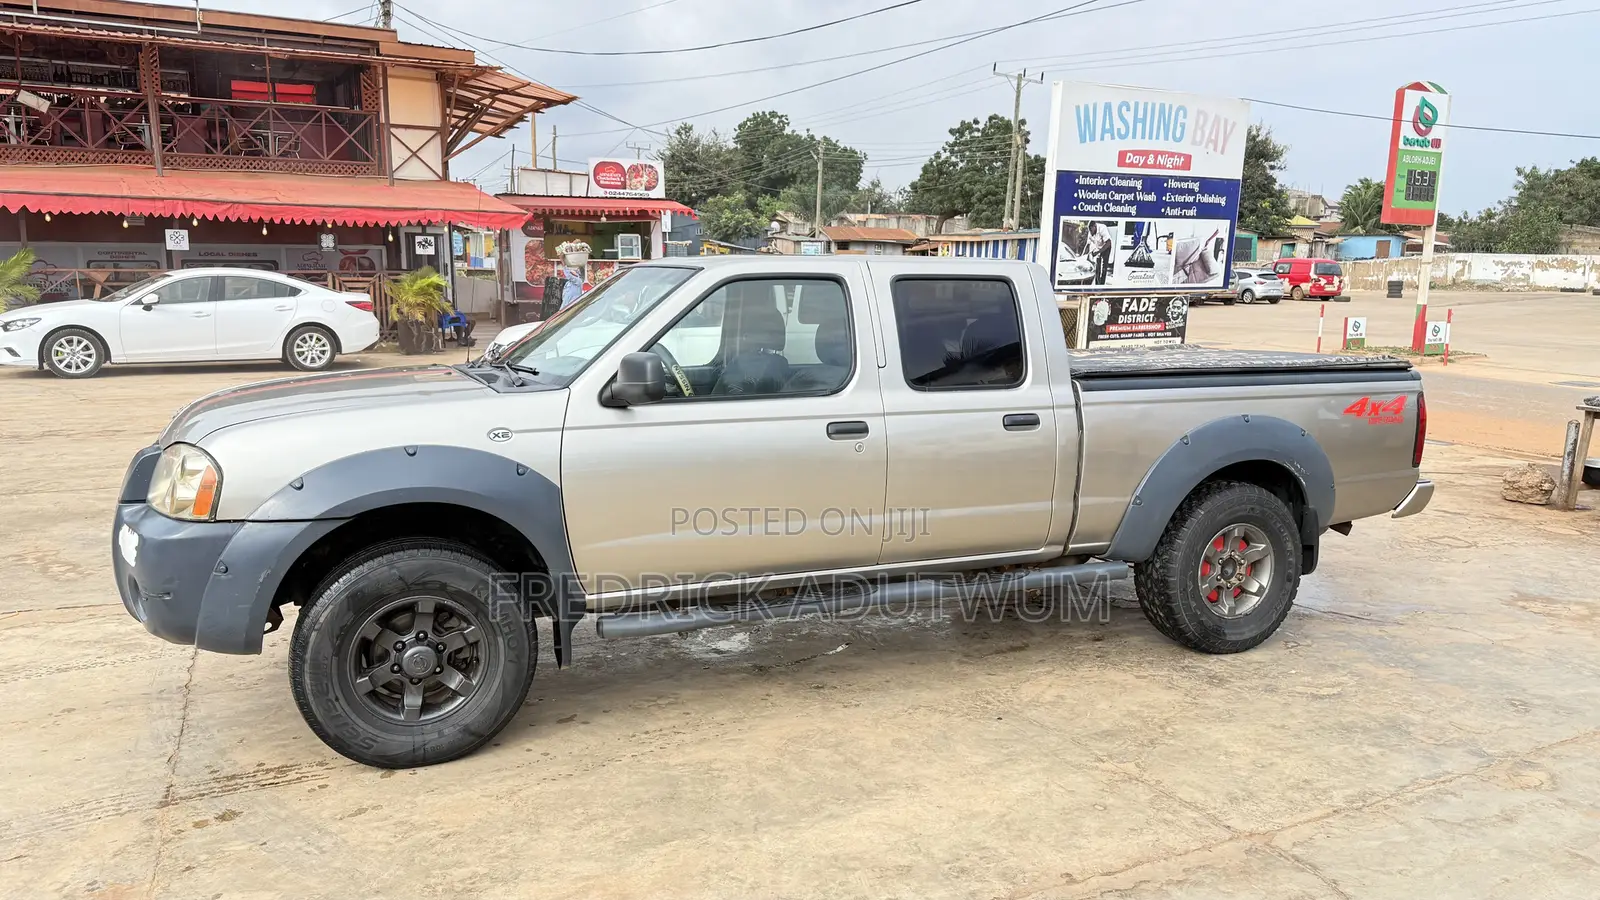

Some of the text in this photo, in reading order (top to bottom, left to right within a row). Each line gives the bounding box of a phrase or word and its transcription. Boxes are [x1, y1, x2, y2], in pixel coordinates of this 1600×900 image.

[1075, 100, 1237, 155] WASHING BAY
[1125, 153, 1185, 168] Day & Night
[1079, 175, 1143, 190] Interior Cleaning
[1168, 179, 1200, 192] Hovering
[1078, 189, 1157, 203] Woolen Carpet Wash
[1166, 194, 1227, 206] Exterior Polishing
[1078, 202, 1137, 216] Couch Cleaning
[1165, 206, 1198, 216] Anti-rust
[1121, 298, 1158, 312] FADE
[1118, 314, 1154, 324] DISTRICT
[492, 431, 510, 439] XE
